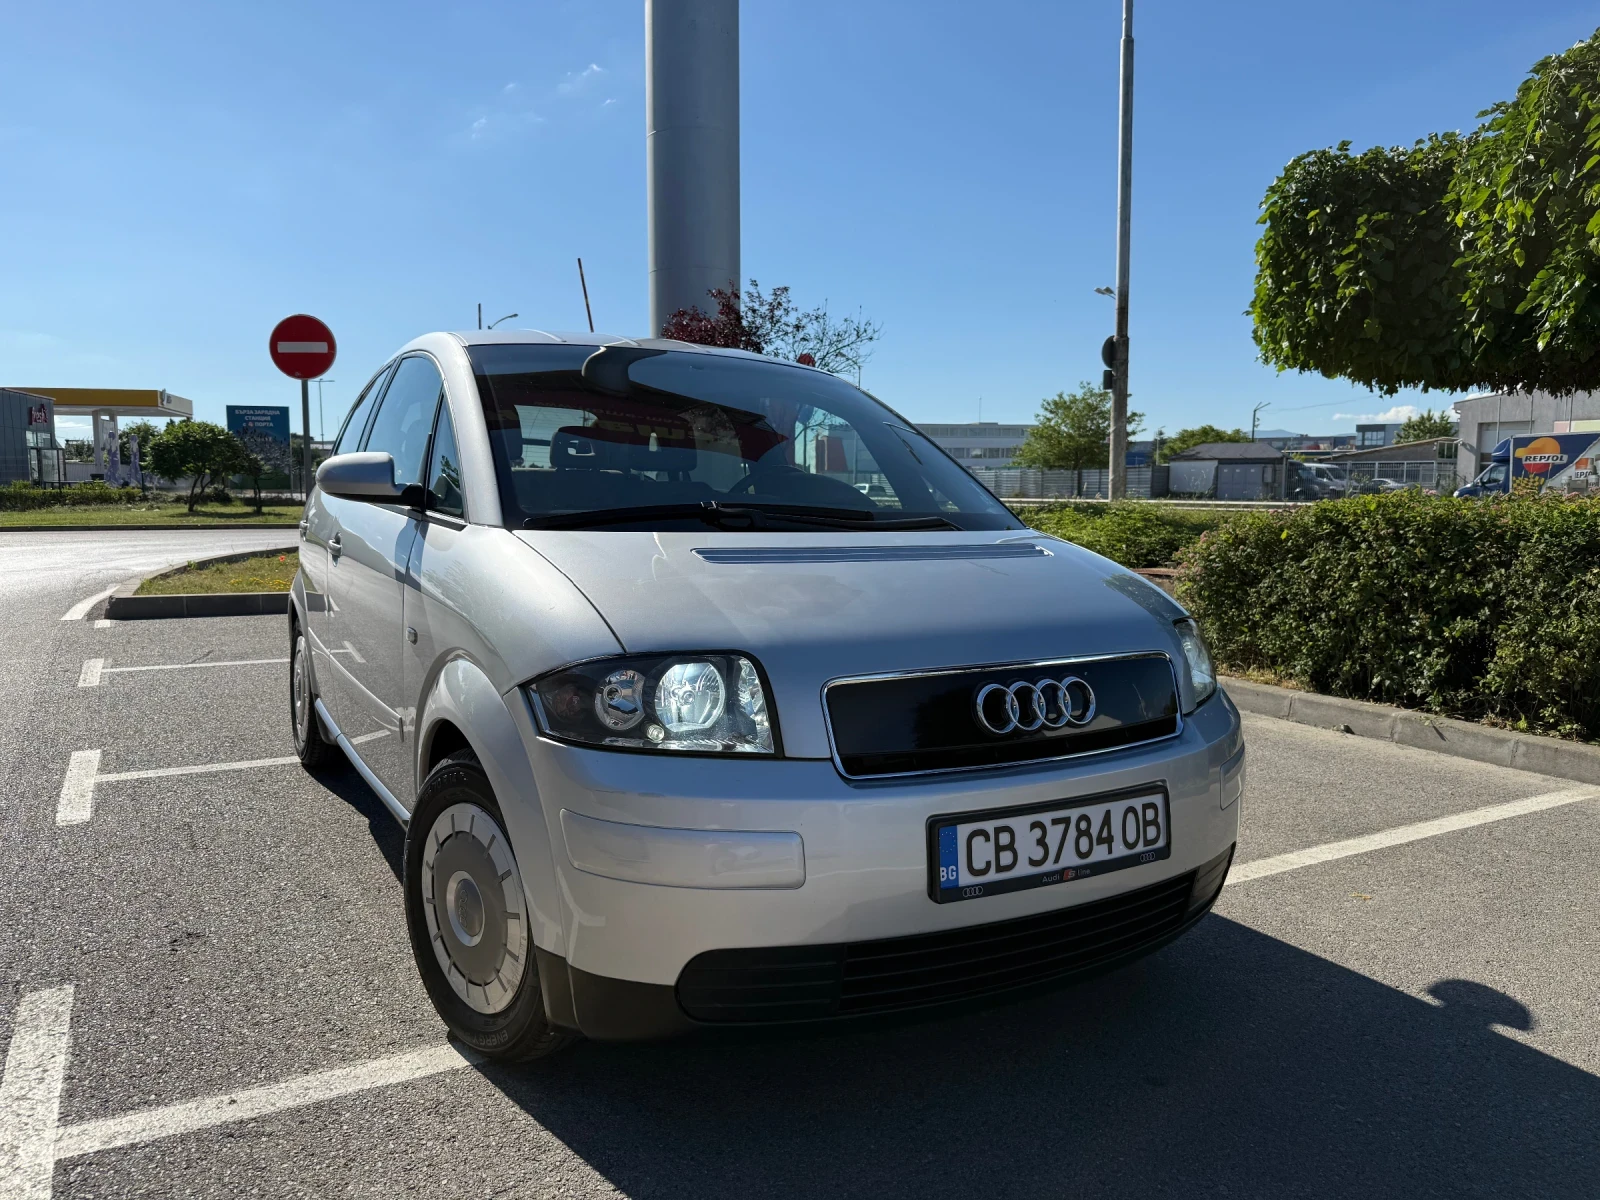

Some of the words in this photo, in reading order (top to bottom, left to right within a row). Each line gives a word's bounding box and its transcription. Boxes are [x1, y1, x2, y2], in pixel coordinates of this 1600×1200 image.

[966, 826, 1018, 877] CB
[1028, 809, 1114, 867] 3784
[1122, 802, 1161, 850] OB
[940, 866, 957, 882] BG
[1042, 873, 1060, 883] Audi
[1077, 867, 1091, 876] line
[472, 1029, 509, 1047] ENERGY
